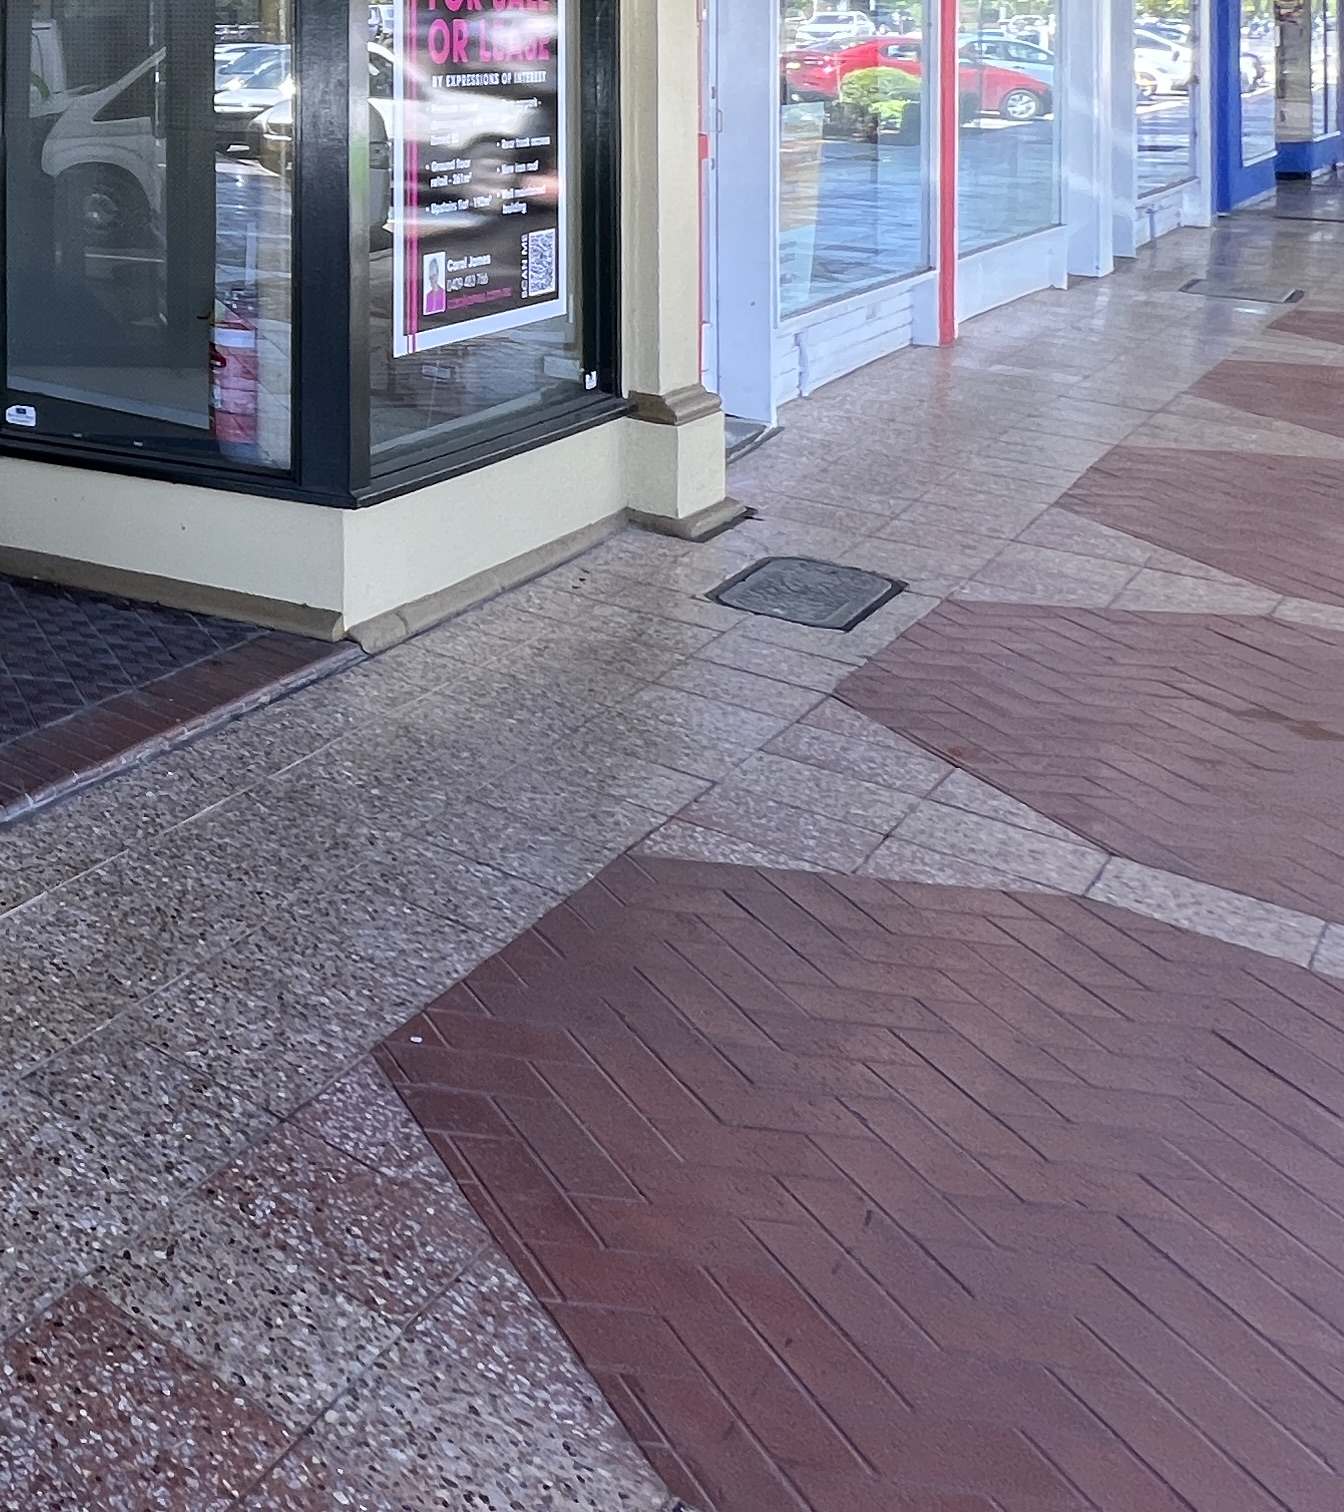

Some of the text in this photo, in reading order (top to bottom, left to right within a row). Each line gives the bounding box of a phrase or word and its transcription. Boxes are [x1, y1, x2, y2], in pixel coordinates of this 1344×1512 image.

[428, 18, 468, 64] OR
[432, 75, 444, 88] BY
[445, 72, 500, 88] EXPRESSIONS
[501, 72, 512, 85] OF
